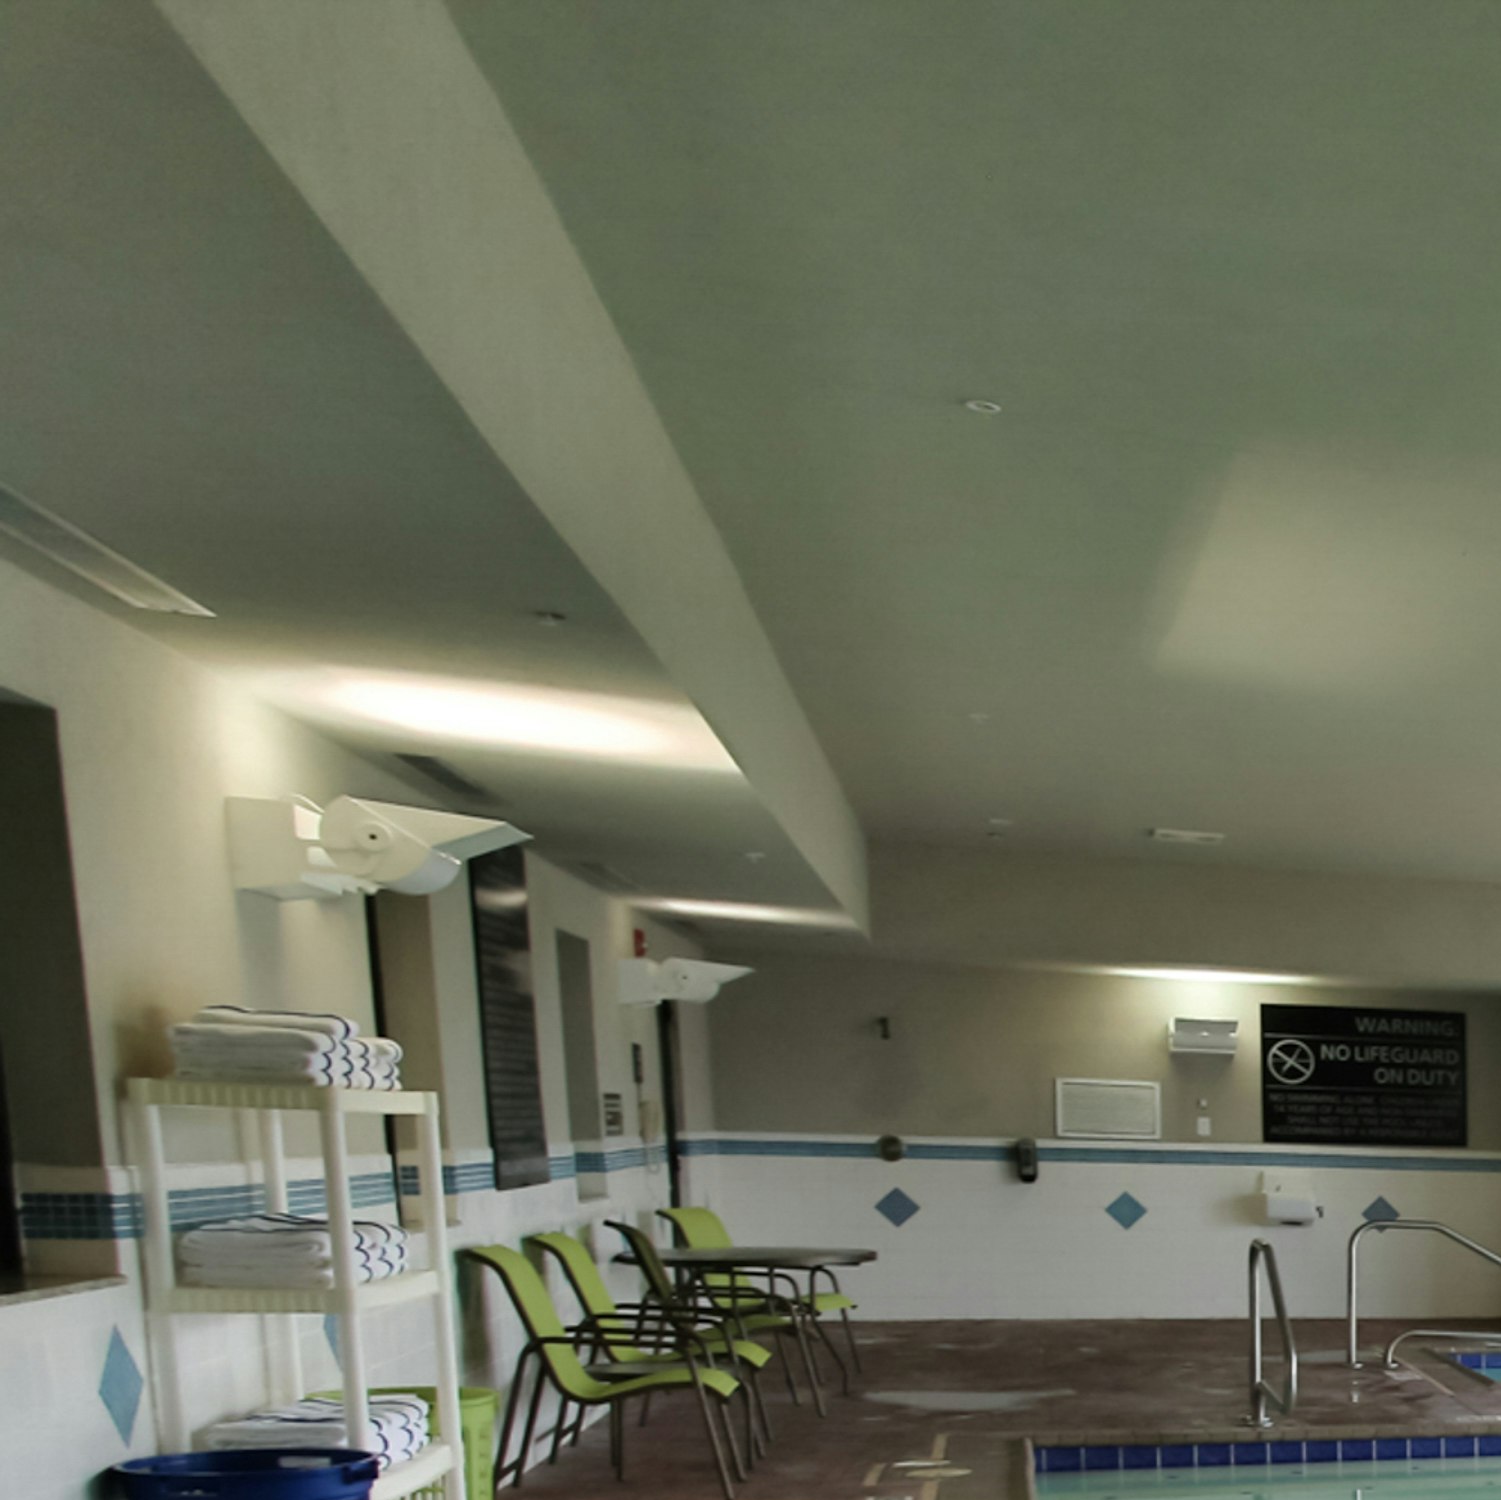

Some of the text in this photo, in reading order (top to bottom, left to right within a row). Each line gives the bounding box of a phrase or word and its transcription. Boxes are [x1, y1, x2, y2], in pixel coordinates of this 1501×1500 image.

[1320, 1044, 1459, 1065] NO LIFEGUARD
[1373, 1068, 1459, 1086] ON DUTY
